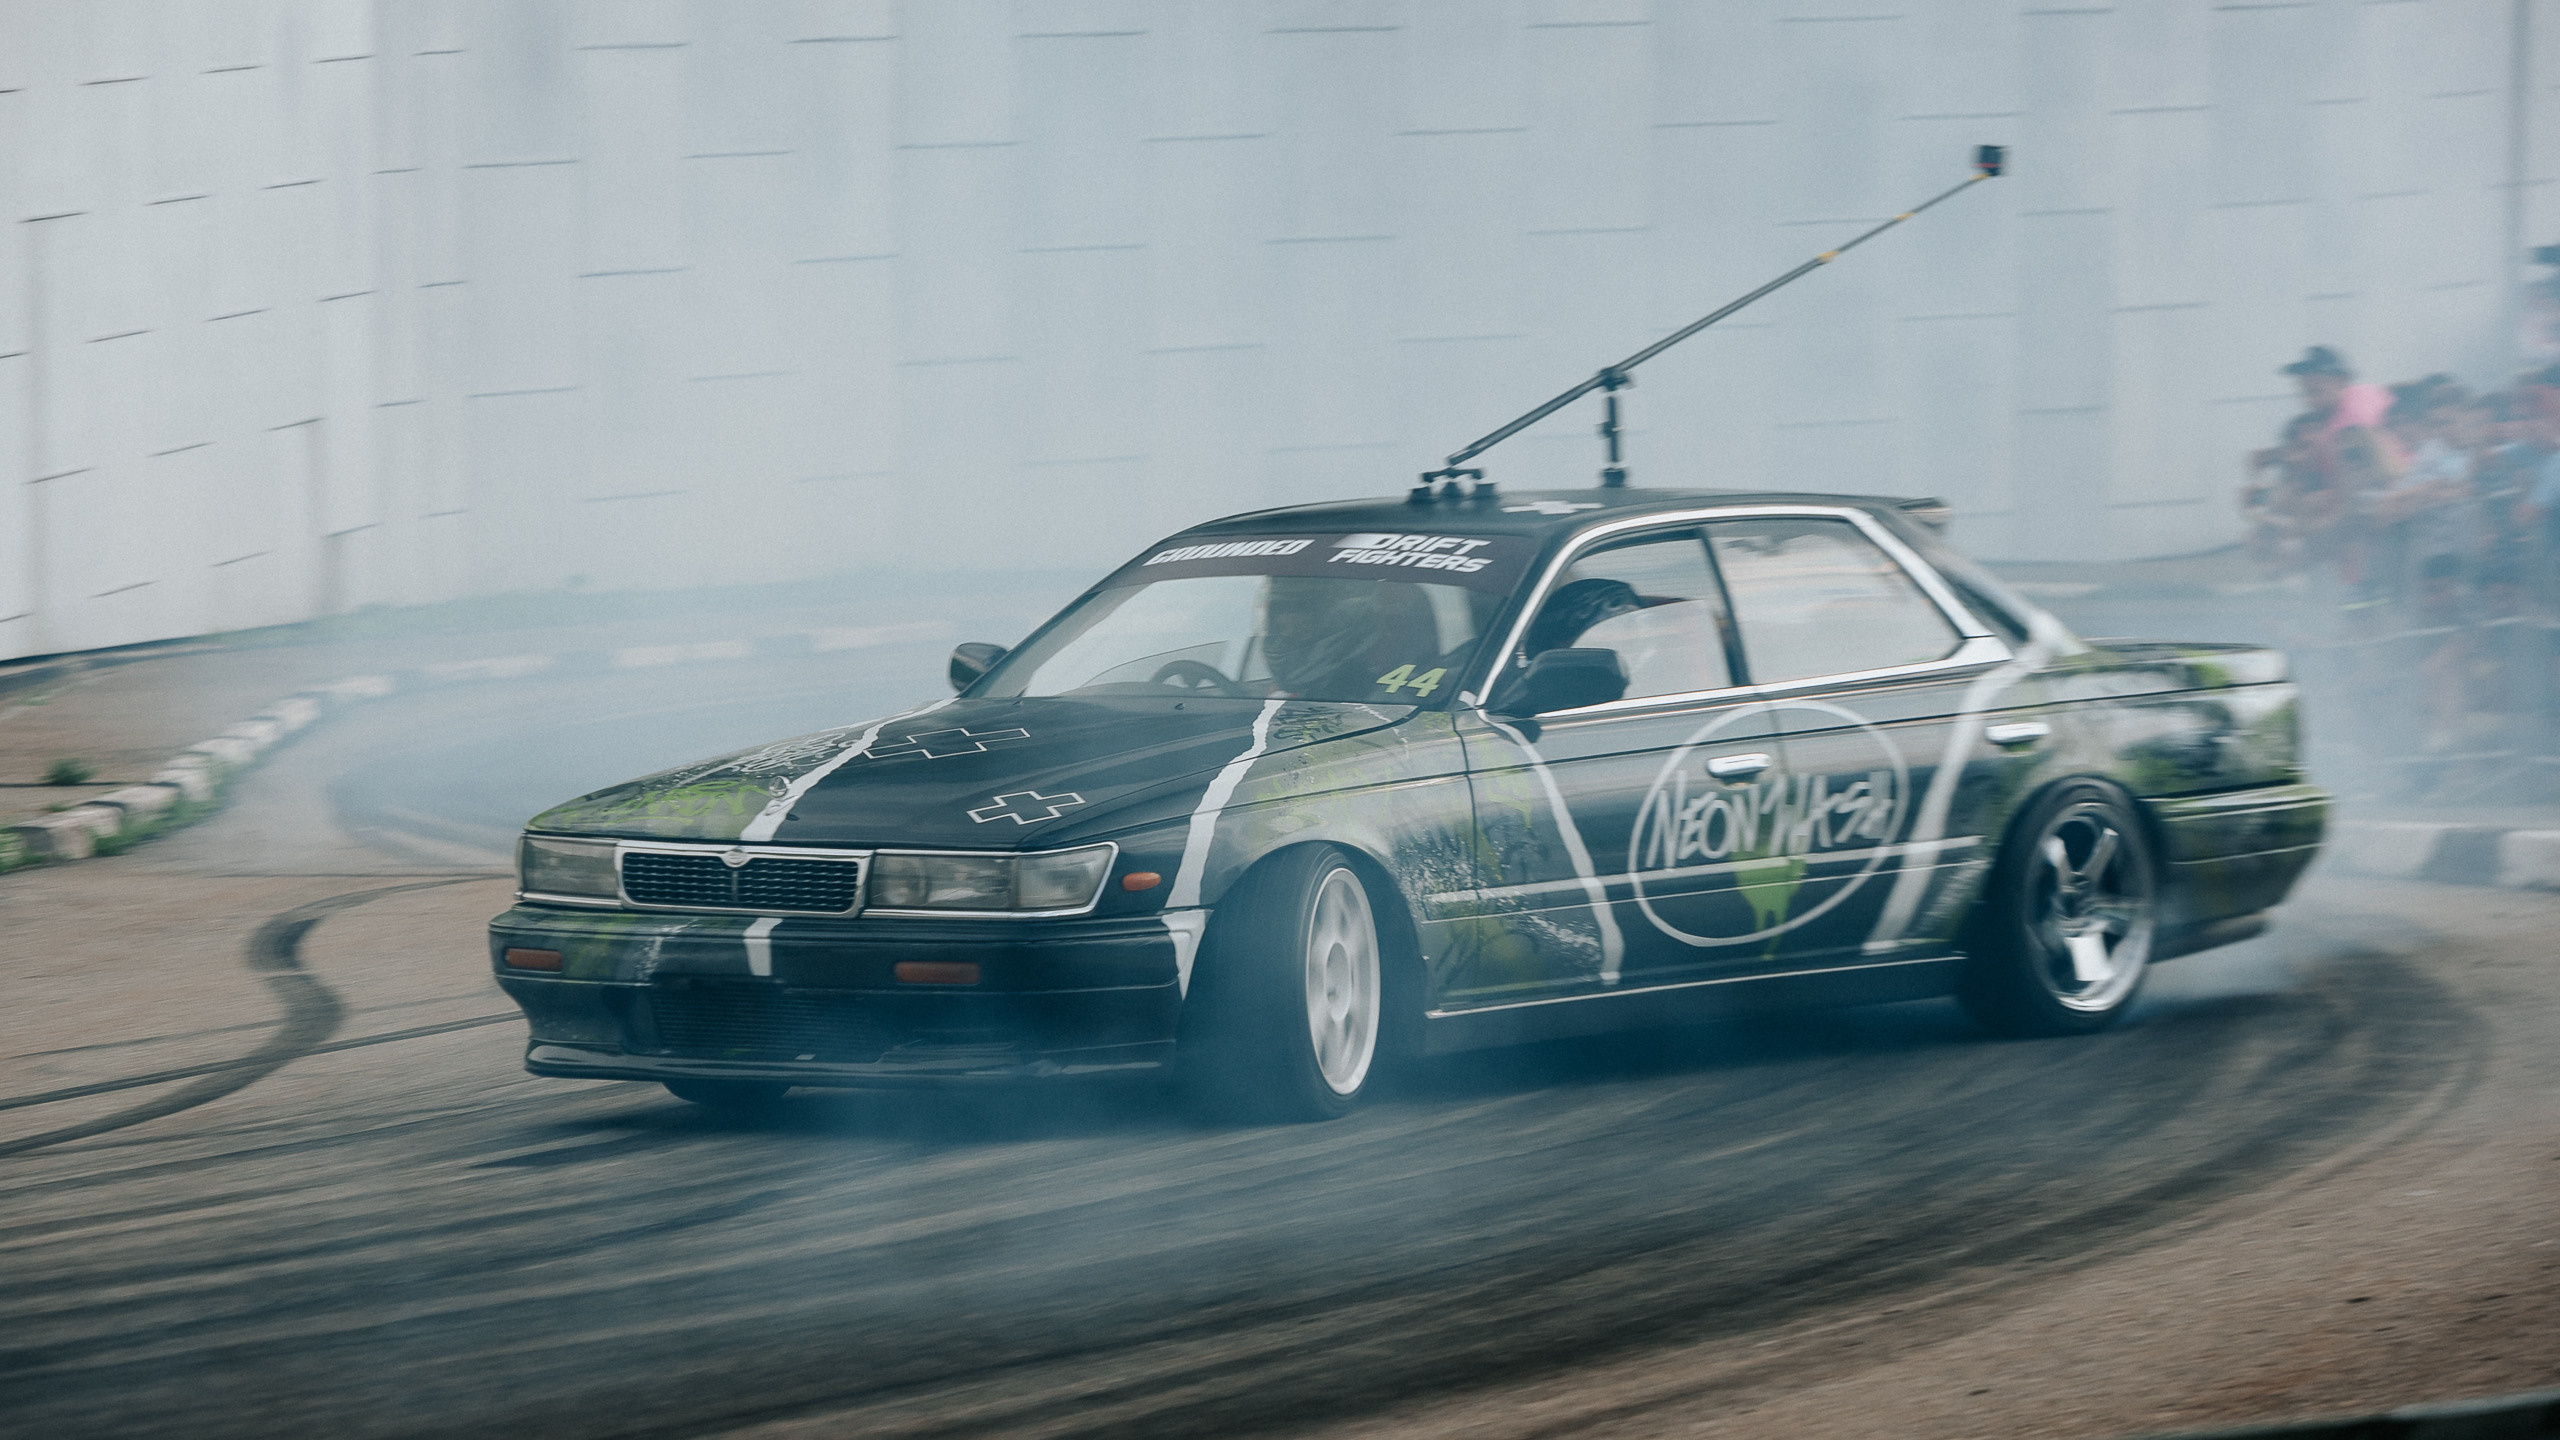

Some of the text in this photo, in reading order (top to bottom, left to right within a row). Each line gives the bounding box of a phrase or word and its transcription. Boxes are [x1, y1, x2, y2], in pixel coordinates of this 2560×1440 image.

[1142, 539, 1316, 567] GROUNDED
[1362, 533, 1492, 556] DRIFT
[1327, 549, 1494, 573] FIGHTERS
[1376, 664, 1448, 697] 44
